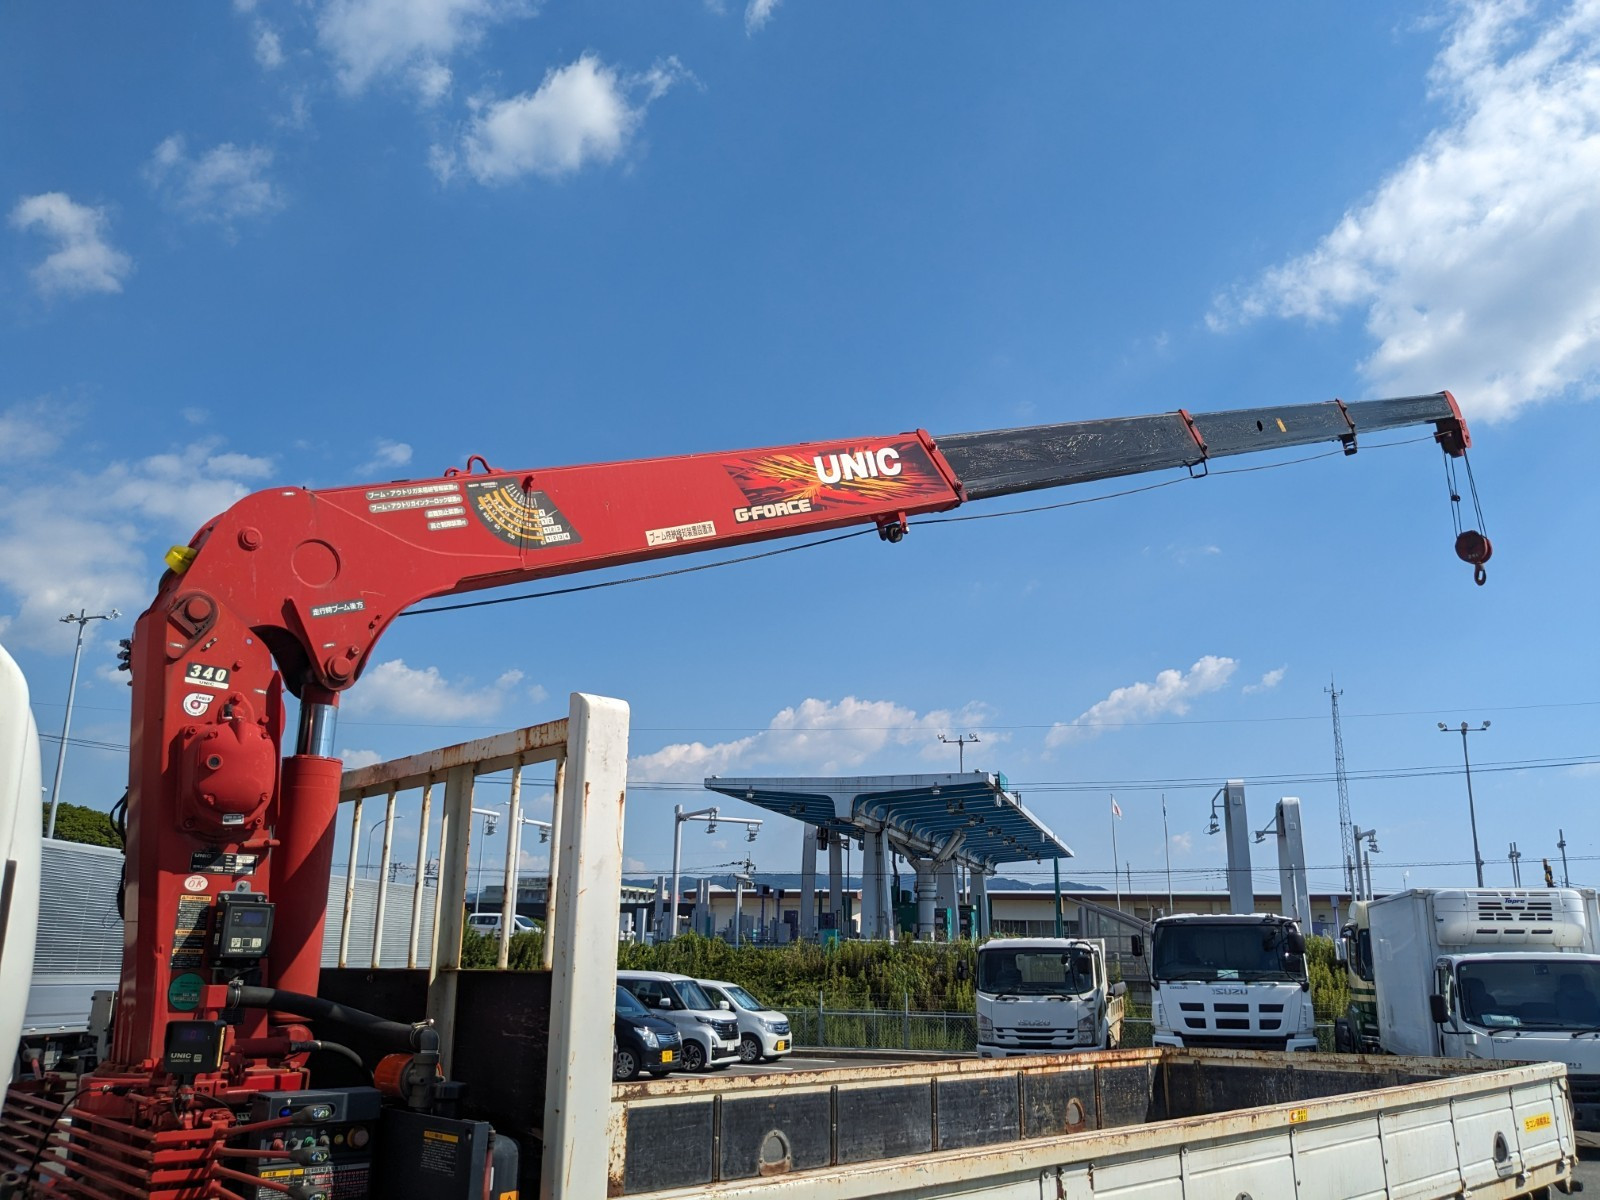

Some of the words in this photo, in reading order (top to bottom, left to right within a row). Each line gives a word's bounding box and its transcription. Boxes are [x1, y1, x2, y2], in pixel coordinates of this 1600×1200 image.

[814, 448, 902, 484] UNIC
[734, 499, 812, 522] G-FORCE
[312, 602, 364, 616] 走行時ブーム後方
[190, 665, 227, 681] 340
[188, 880, 203, 888] OK
